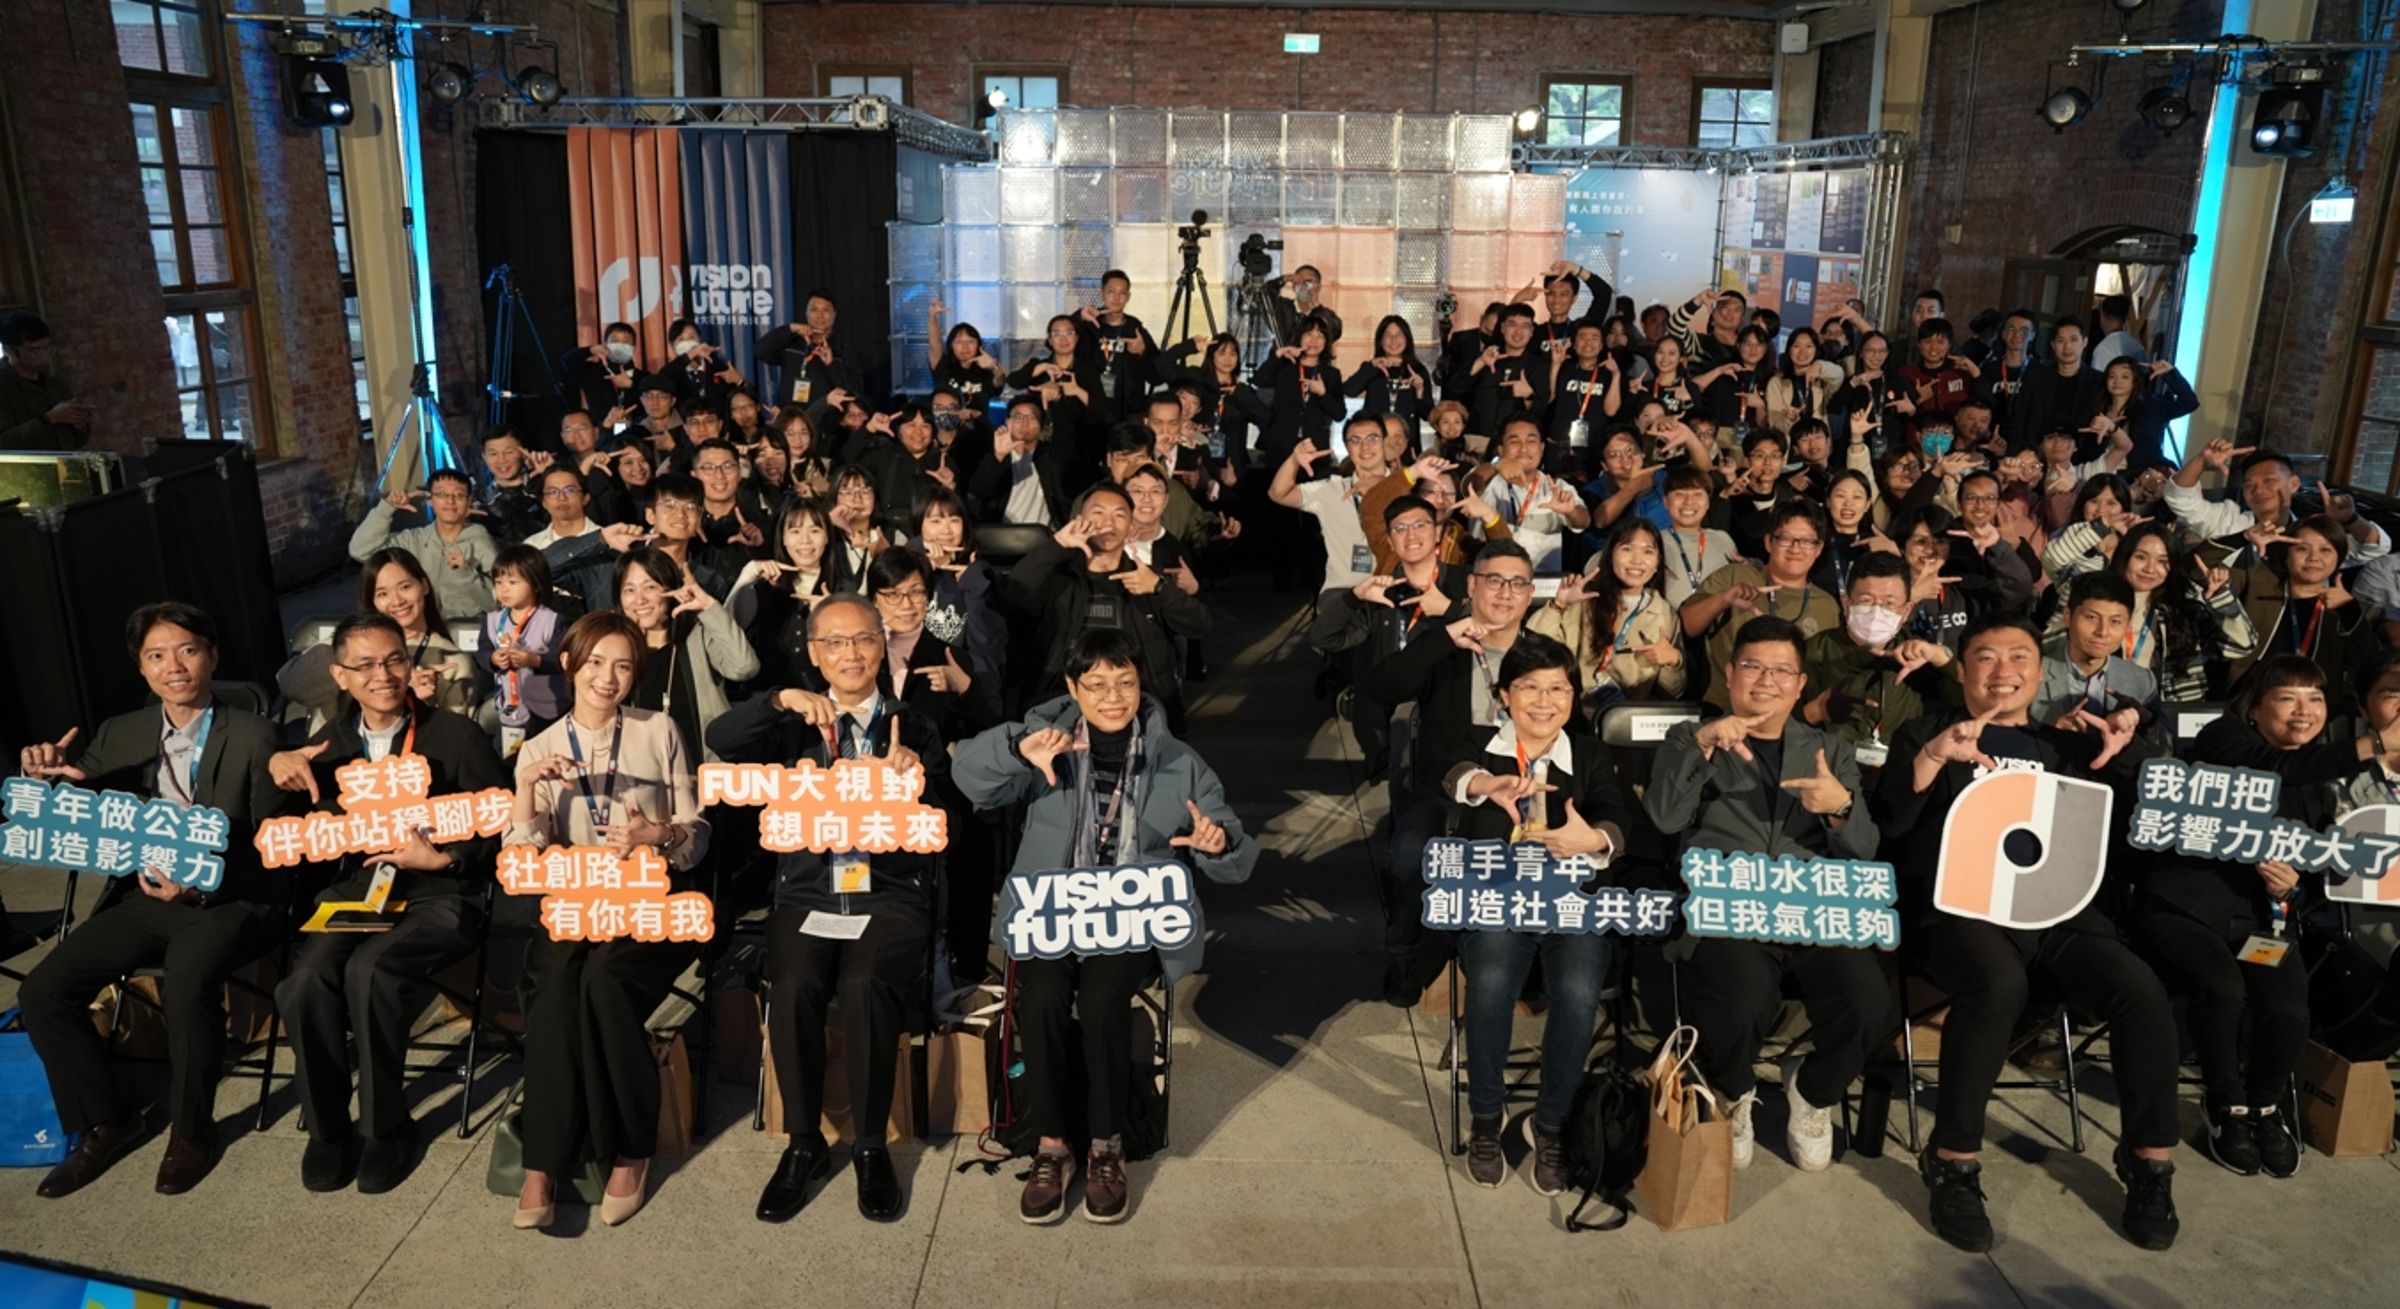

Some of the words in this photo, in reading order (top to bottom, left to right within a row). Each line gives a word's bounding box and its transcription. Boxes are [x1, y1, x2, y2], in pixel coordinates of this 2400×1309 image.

[342, 760, 426, 804] 支持
[2144, 764, 2276, 814] 我們把
[7, 783, 224, 847] 青年做公益
[261, 793, 513, 863] 伴你站穩腳步
[766, 810, 942, 848] 想向未來
[3, 824, 220, 887] 創造影響力
[1428, 843, 1591, 883] 攜手青年
[2134, 808, 2400, 875] 影響力放大了
[502, 851, 665, 889] 社創路上
[1011, 864, 1188, 911] vision
[1687, 853, 1892, 901] 社創水很深
[547, 899, 709, 936] 有你有我
[1008, 904, 1192, 954] future
[1427, 888, 1674, 931] 創造社會共好
[1688, 896, 1894, 944] 但我氣很夠
